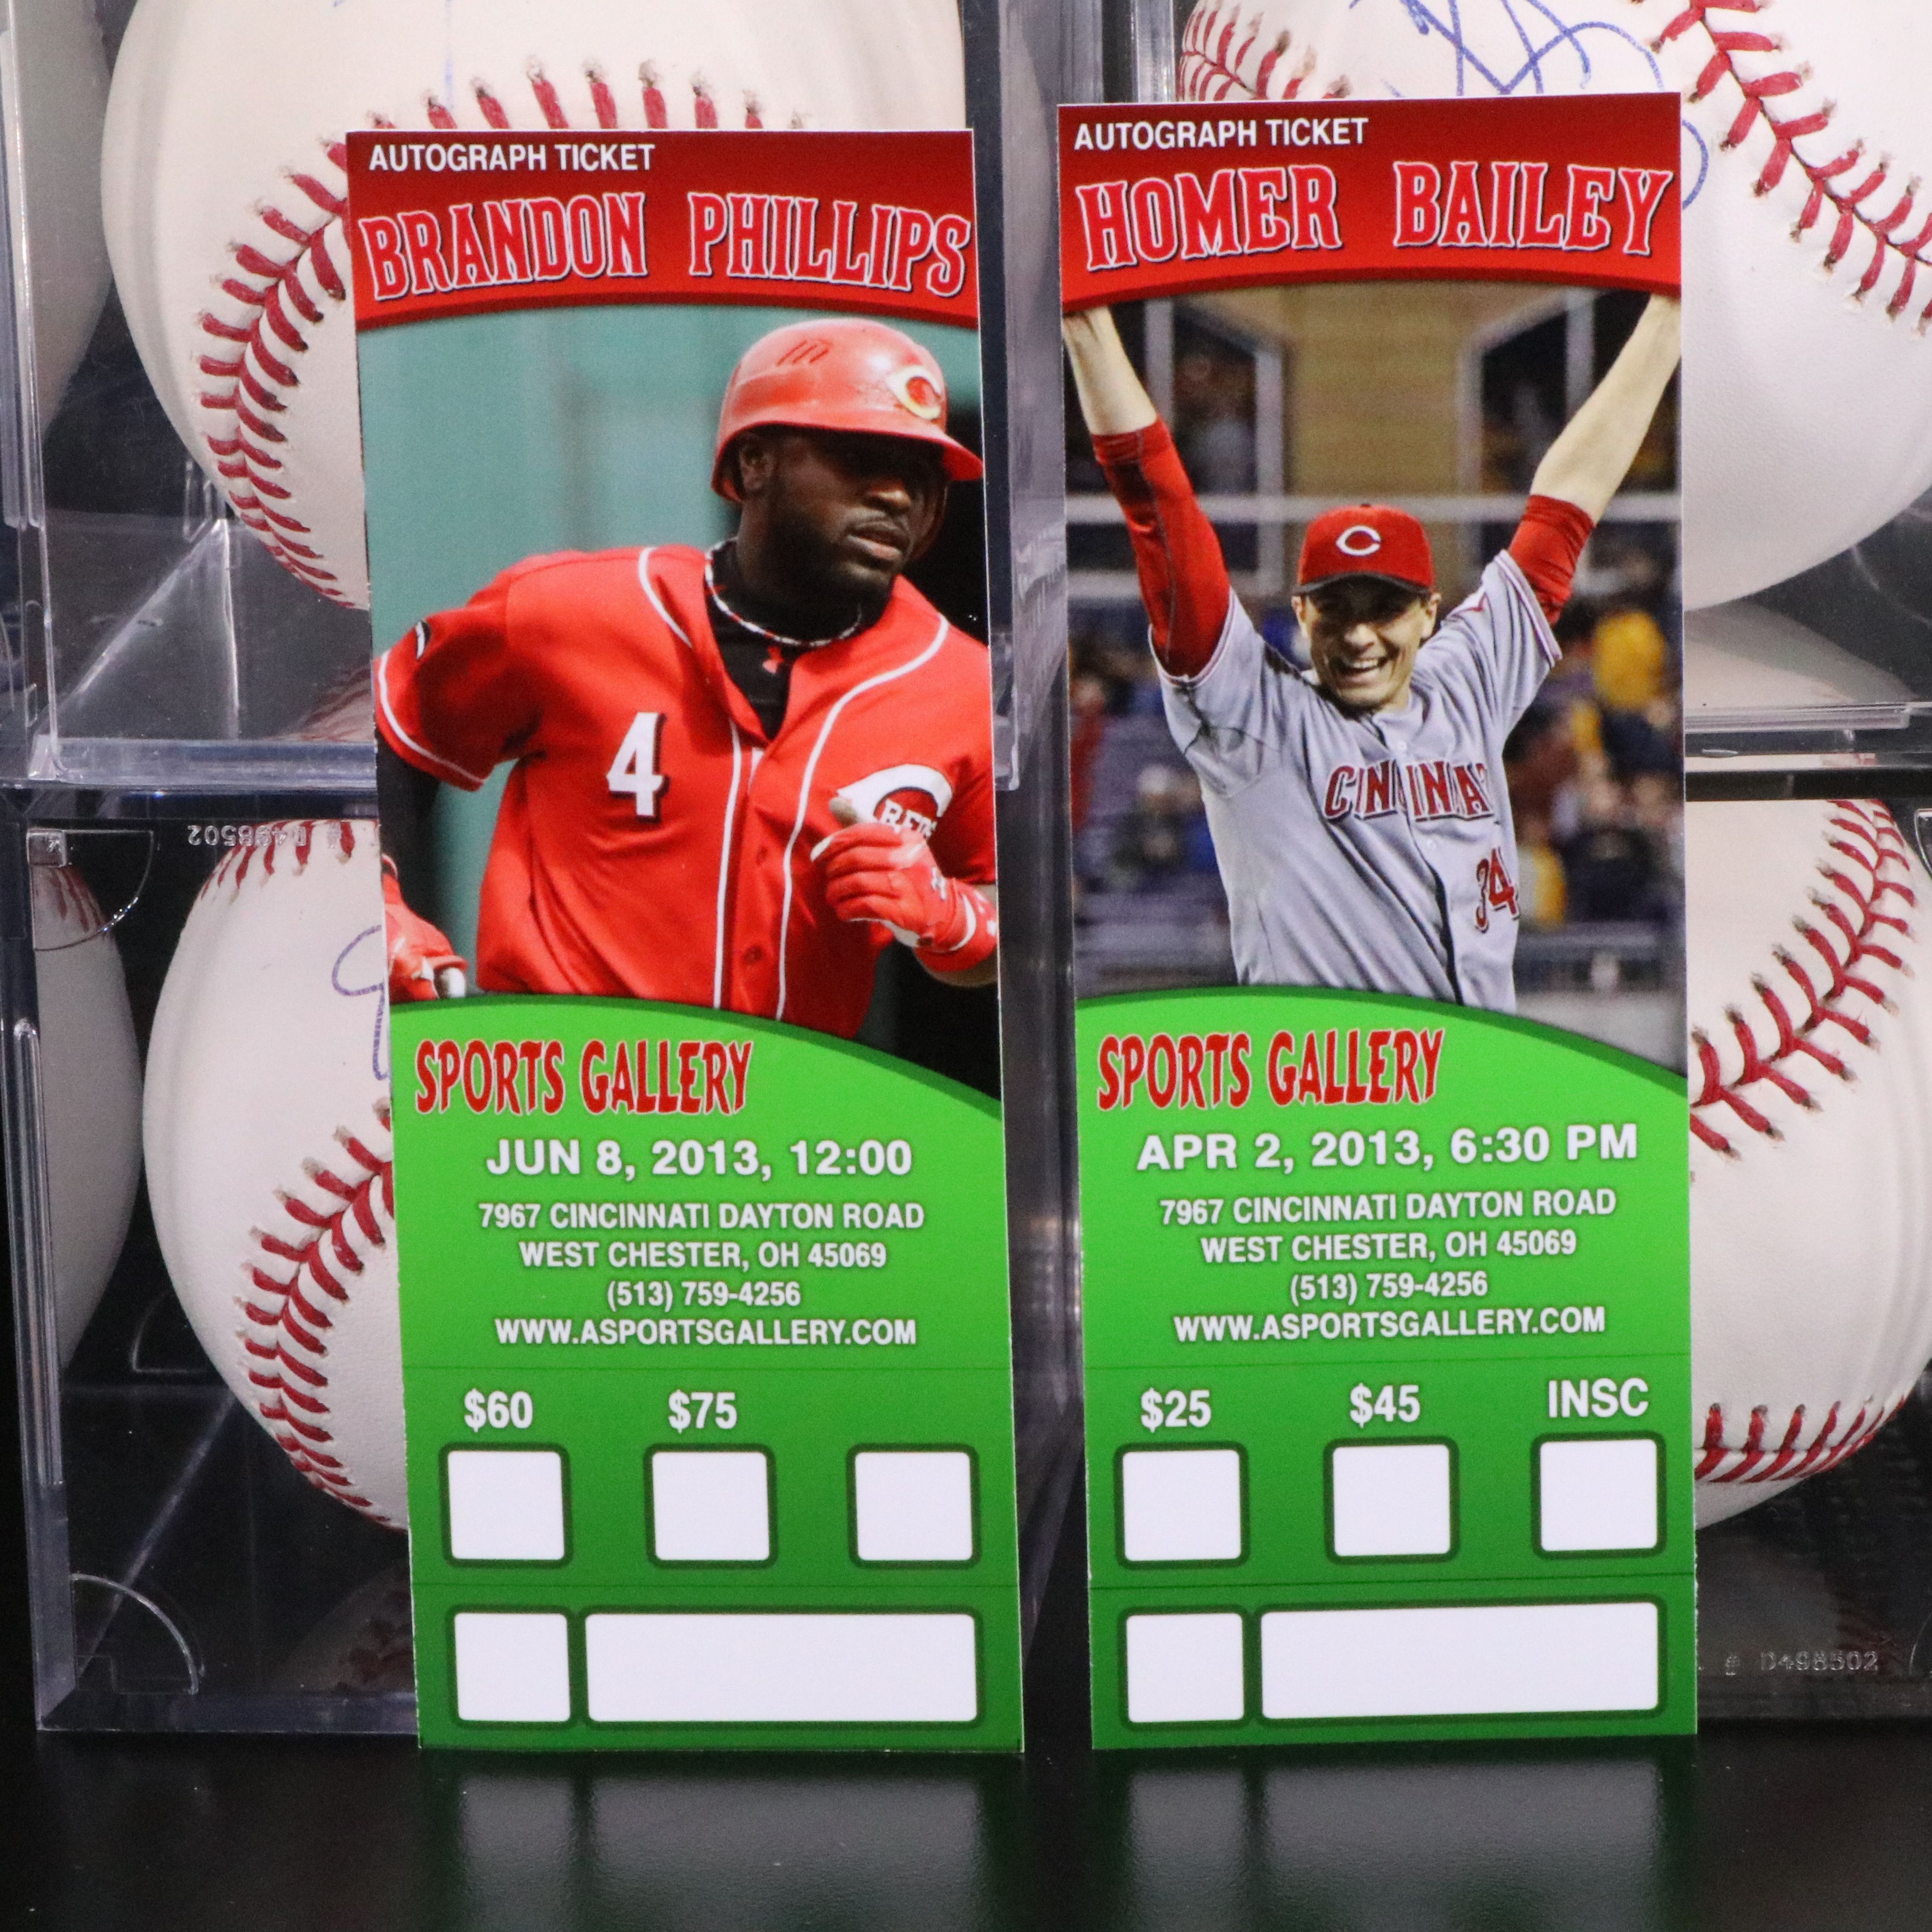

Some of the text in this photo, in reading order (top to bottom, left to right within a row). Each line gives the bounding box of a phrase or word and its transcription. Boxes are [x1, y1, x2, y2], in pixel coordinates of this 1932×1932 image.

[1075, 118, 1368, 150] AUTOGRAPH TICKET
[369, 144, 654, 171] AUTOGRAPH TICKET
[1075, 164, 1342, 271] HOMER
[1393, 161, 1673, 255] BAILEY
[358, 192, 971, 300] BRANDON PHILLIPS
[606, 711, 668, 823] 4
[1476, 846, 1519, 932] 34
[415, 1039, 753, 1116] SPORTS GALLERY
[1097, 1028, 1445, 1111] SPORTS GALLERY
[487, 1139, 911, 1181] JUN 8, 2013, 12:00
[1137, 1123, 1637, 1174] APR 2, 2013, 6:30 PM
[479, 1203, 924, 1229] 7967 CINCINNATI DAYTON ROAD
[1160, 1189, 1616, 1225] 7967 CINCINNATI DAYTON ROAD
[519, 1241, 886, 1271] WEST CHESTER, OH 45069
[1201, 1229, 1577, 1263] WEST CHESTER, OH 45069
[608, 1281, 800, 1312] (513) 759-4256
[1291, 1271, 1488, 1306] (513) 759-4256
[495, 1319, 916, 1345] WWW.ASPORTSGALLERY.COM
[1174, 1305, 1605, 1341] WWW.ASPORTSGALLERY.COM
[465, 1389, 737, 1433] $60 $75
[1141, 1378, 1648, 1432] $25 $45 INSC
